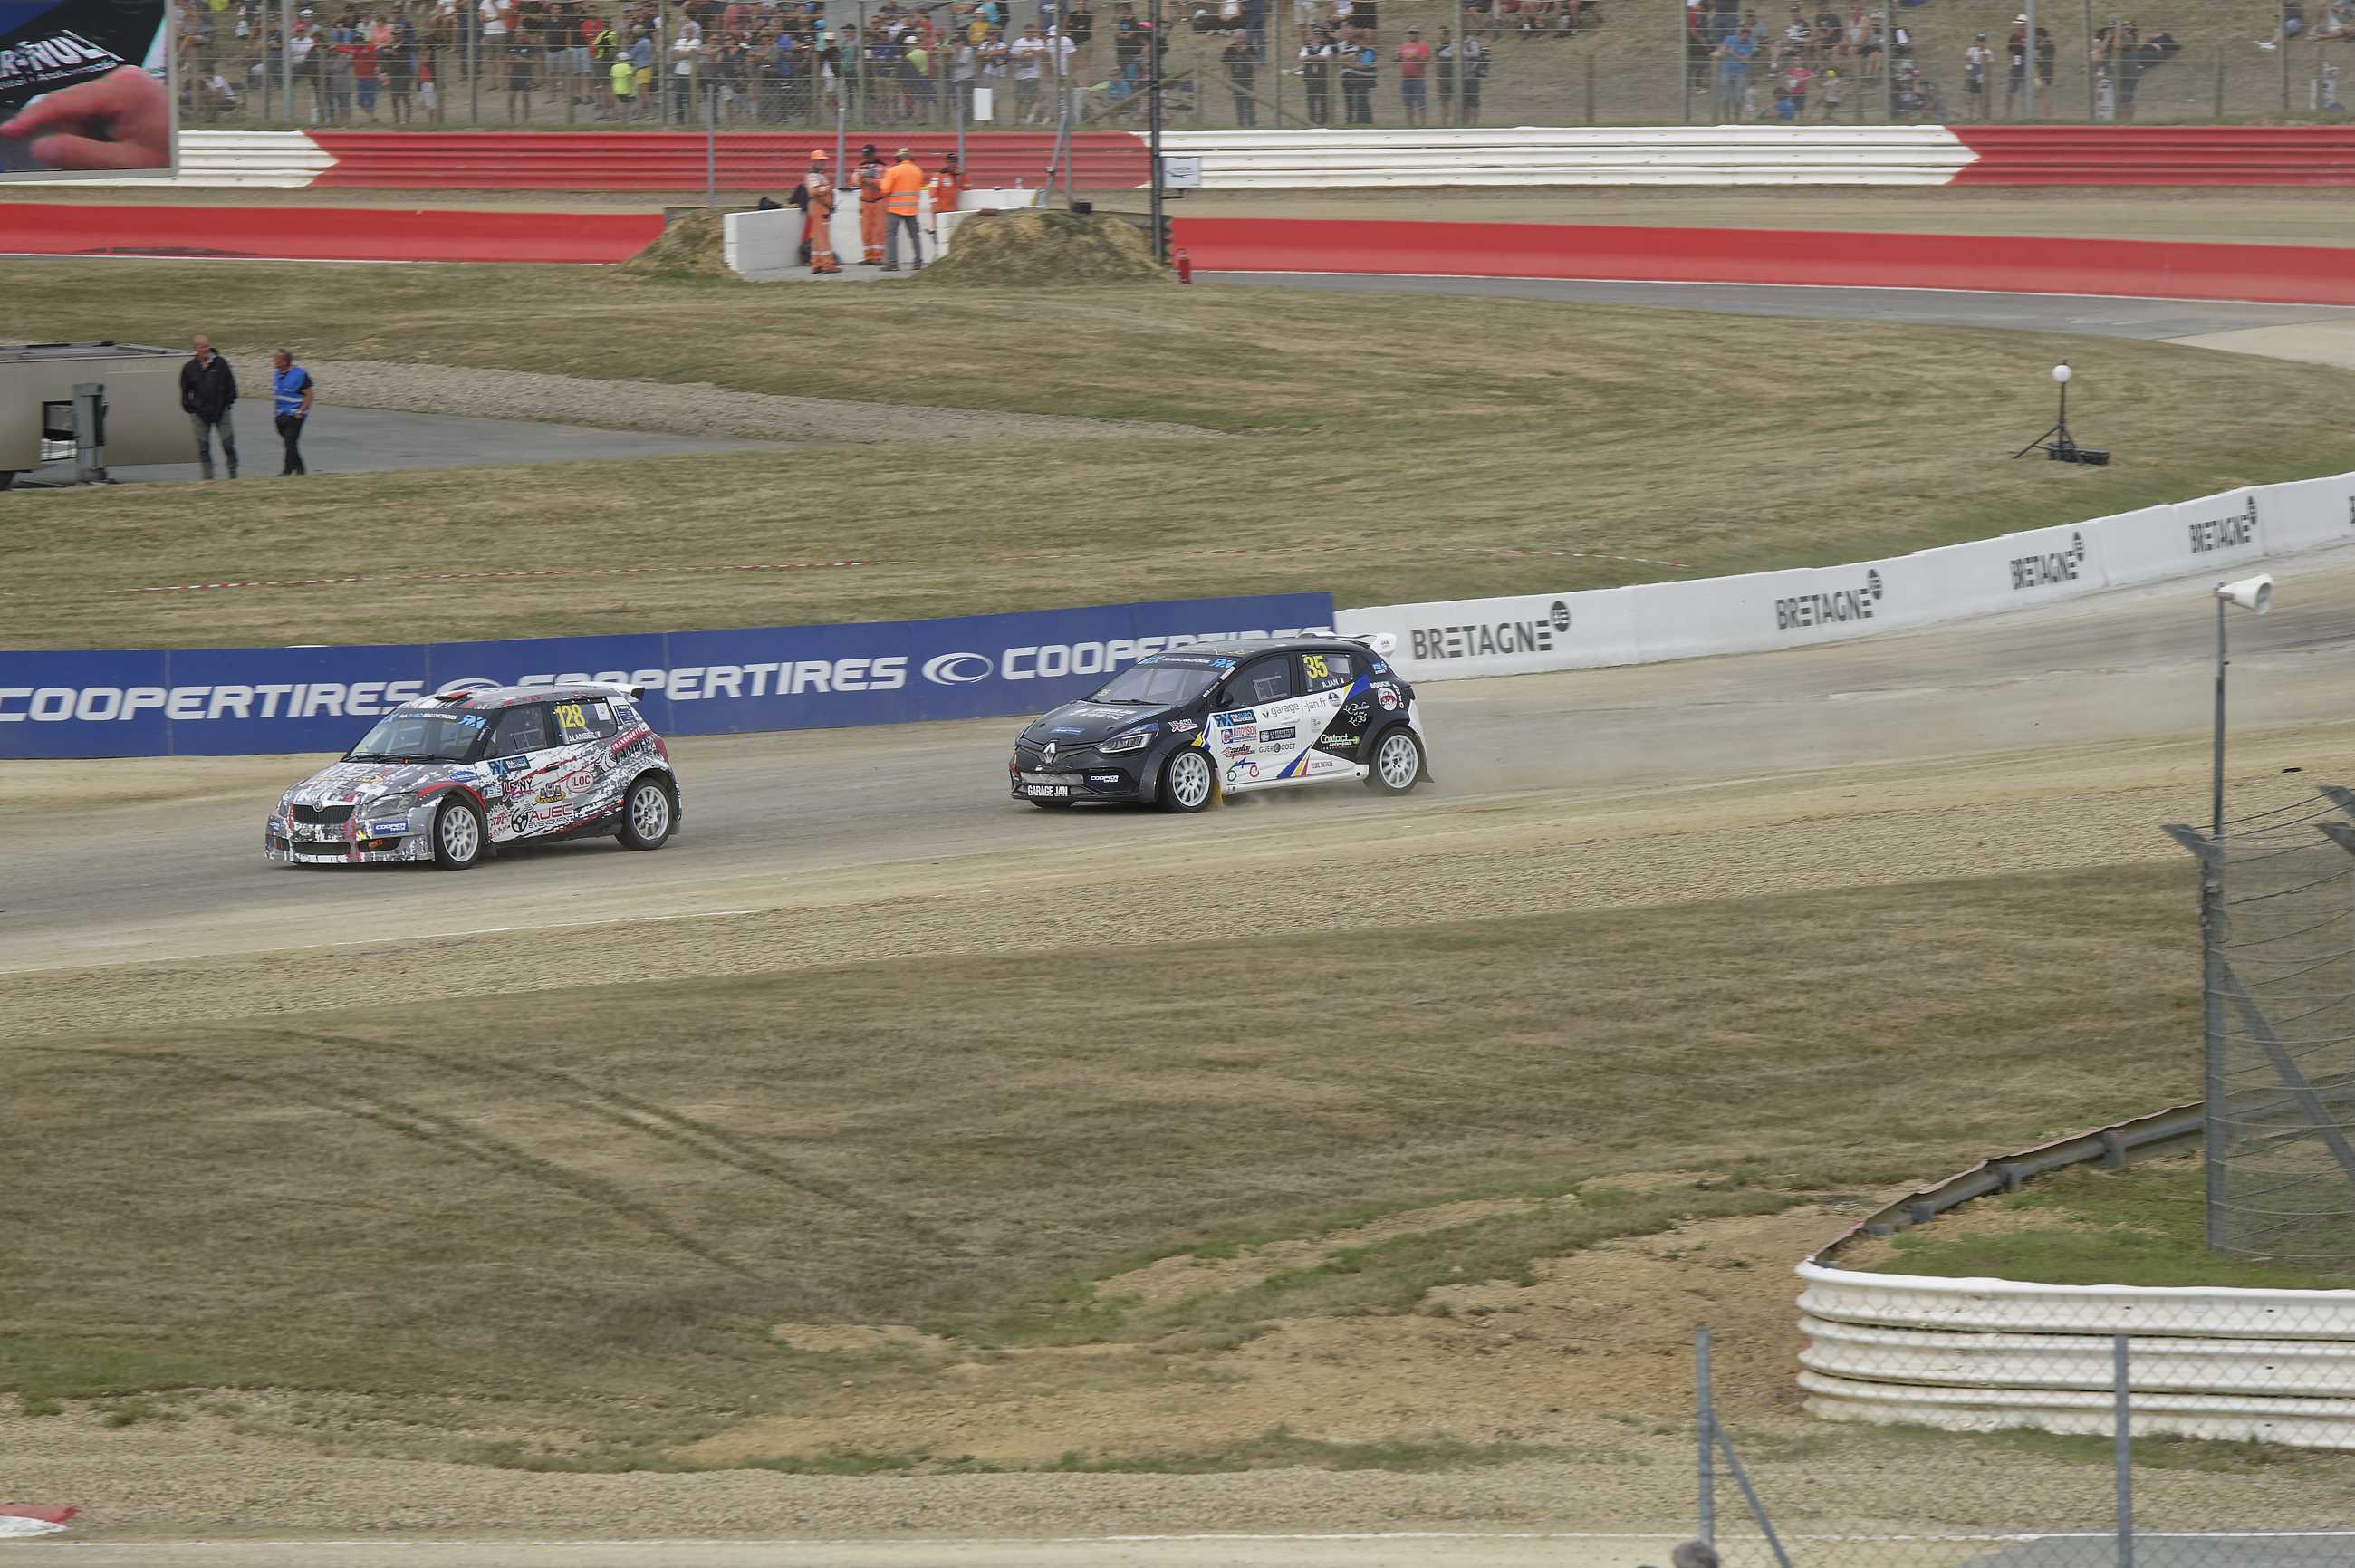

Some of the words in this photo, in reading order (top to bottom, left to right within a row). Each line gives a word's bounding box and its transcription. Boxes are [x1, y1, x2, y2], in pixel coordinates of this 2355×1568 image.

[2188, 514, 2252, 553] BRETAGNE
[2010, 551, 2079, 590] BRETAGNE
[1775, 588, 1873, 630] BRETAGNE
[1412, 620, 1552, 660] BRETAGNE
[1304, 656, 1328, 678] 35
[554, 704, 586, 728] 128
[1270, 702, 1300, 717] garage
[1028, 785, 1054, 796] GARAGE
[1054, 786, 1068, 797] JAN
[529, 803, 574, 821] AJEC
